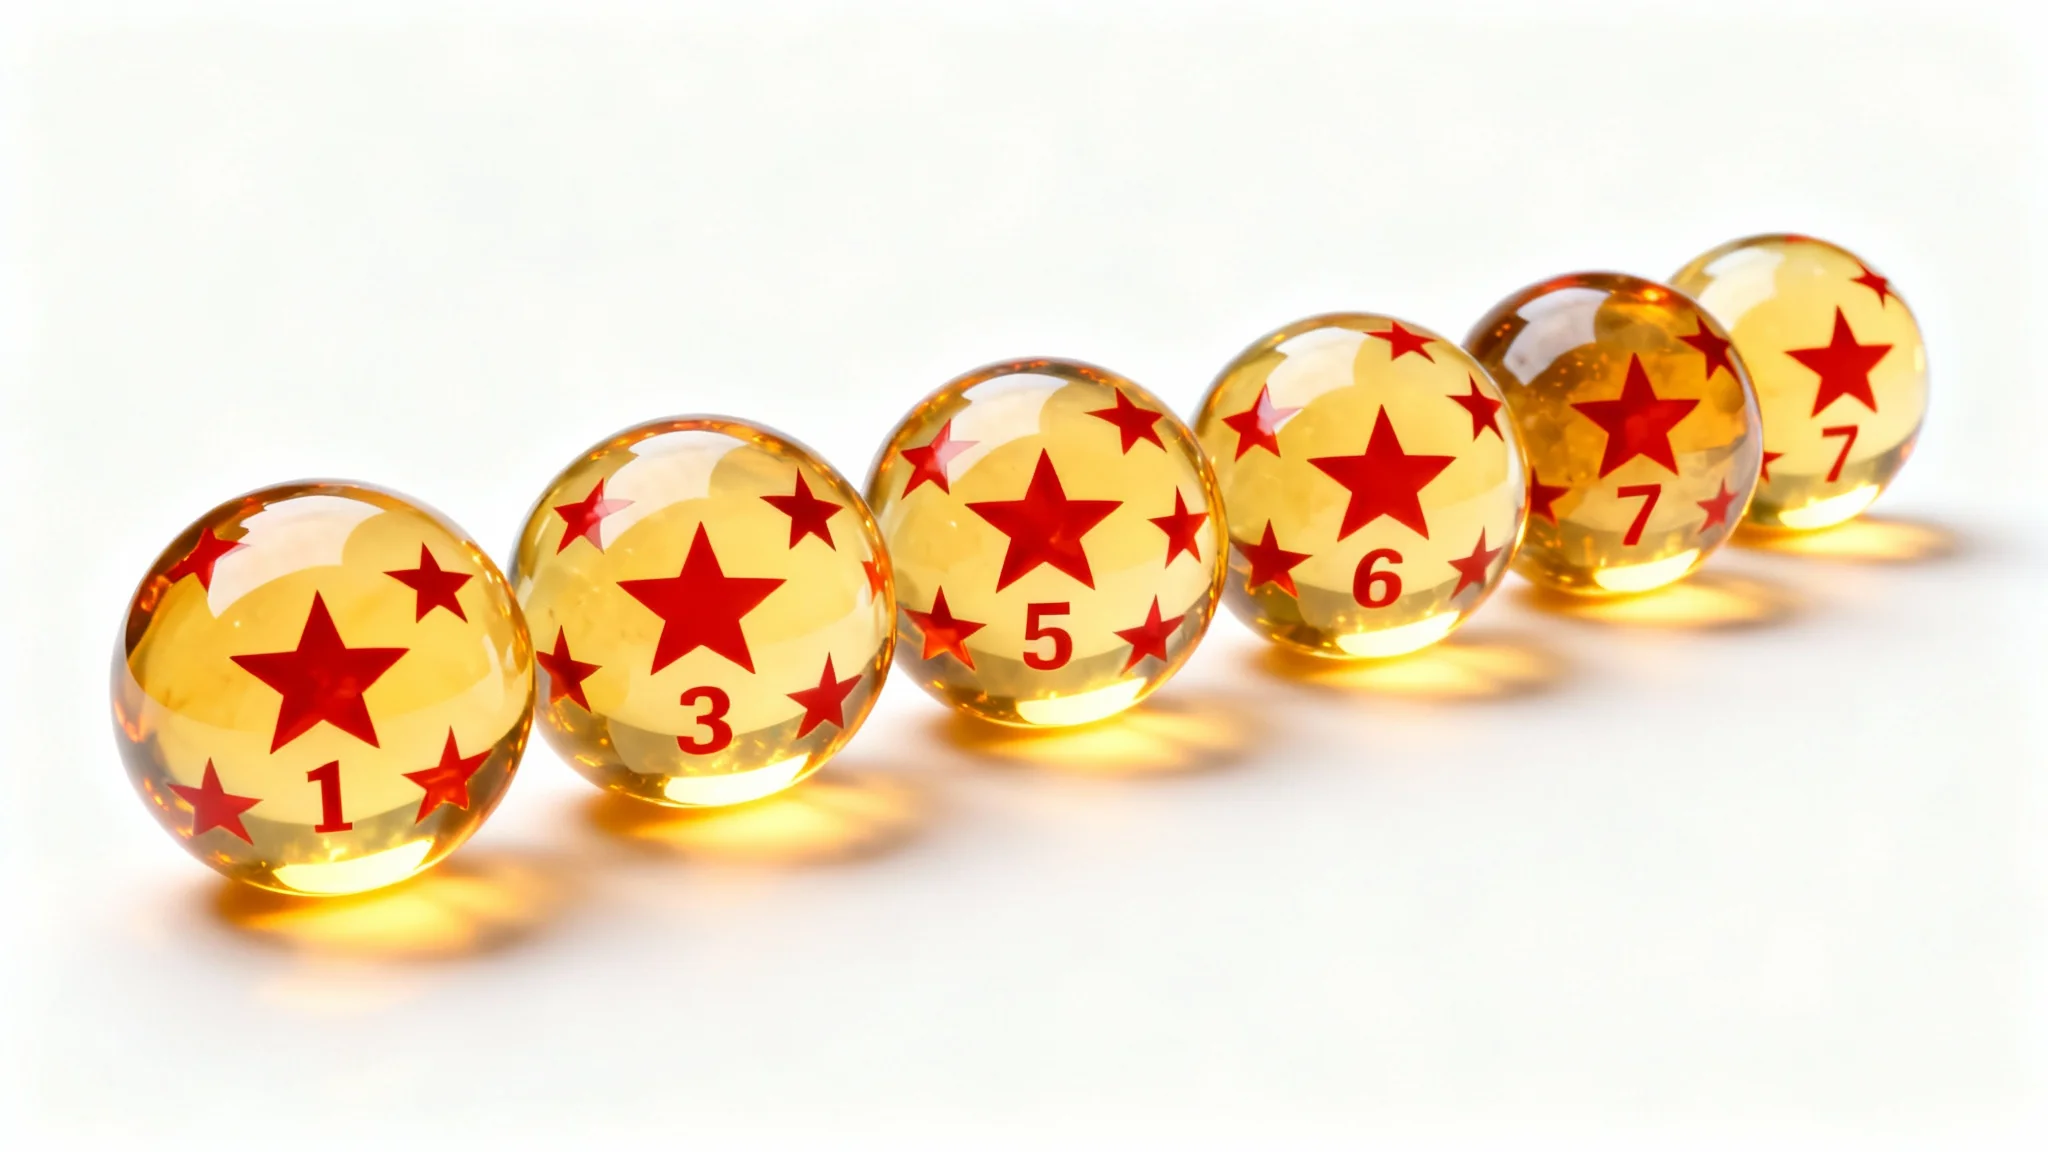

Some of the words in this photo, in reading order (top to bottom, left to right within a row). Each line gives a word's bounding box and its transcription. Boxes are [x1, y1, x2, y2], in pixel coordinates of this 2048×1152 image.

[1822, 425, 1858, 482] 7
[1617, 484, 1662, 546] 7
[1353, 548, 1403, 609] 6
[1022, 602, 1073, 671] 5
[676, 686, 733, 755] 3
[306, 760, 353, 833] 1
